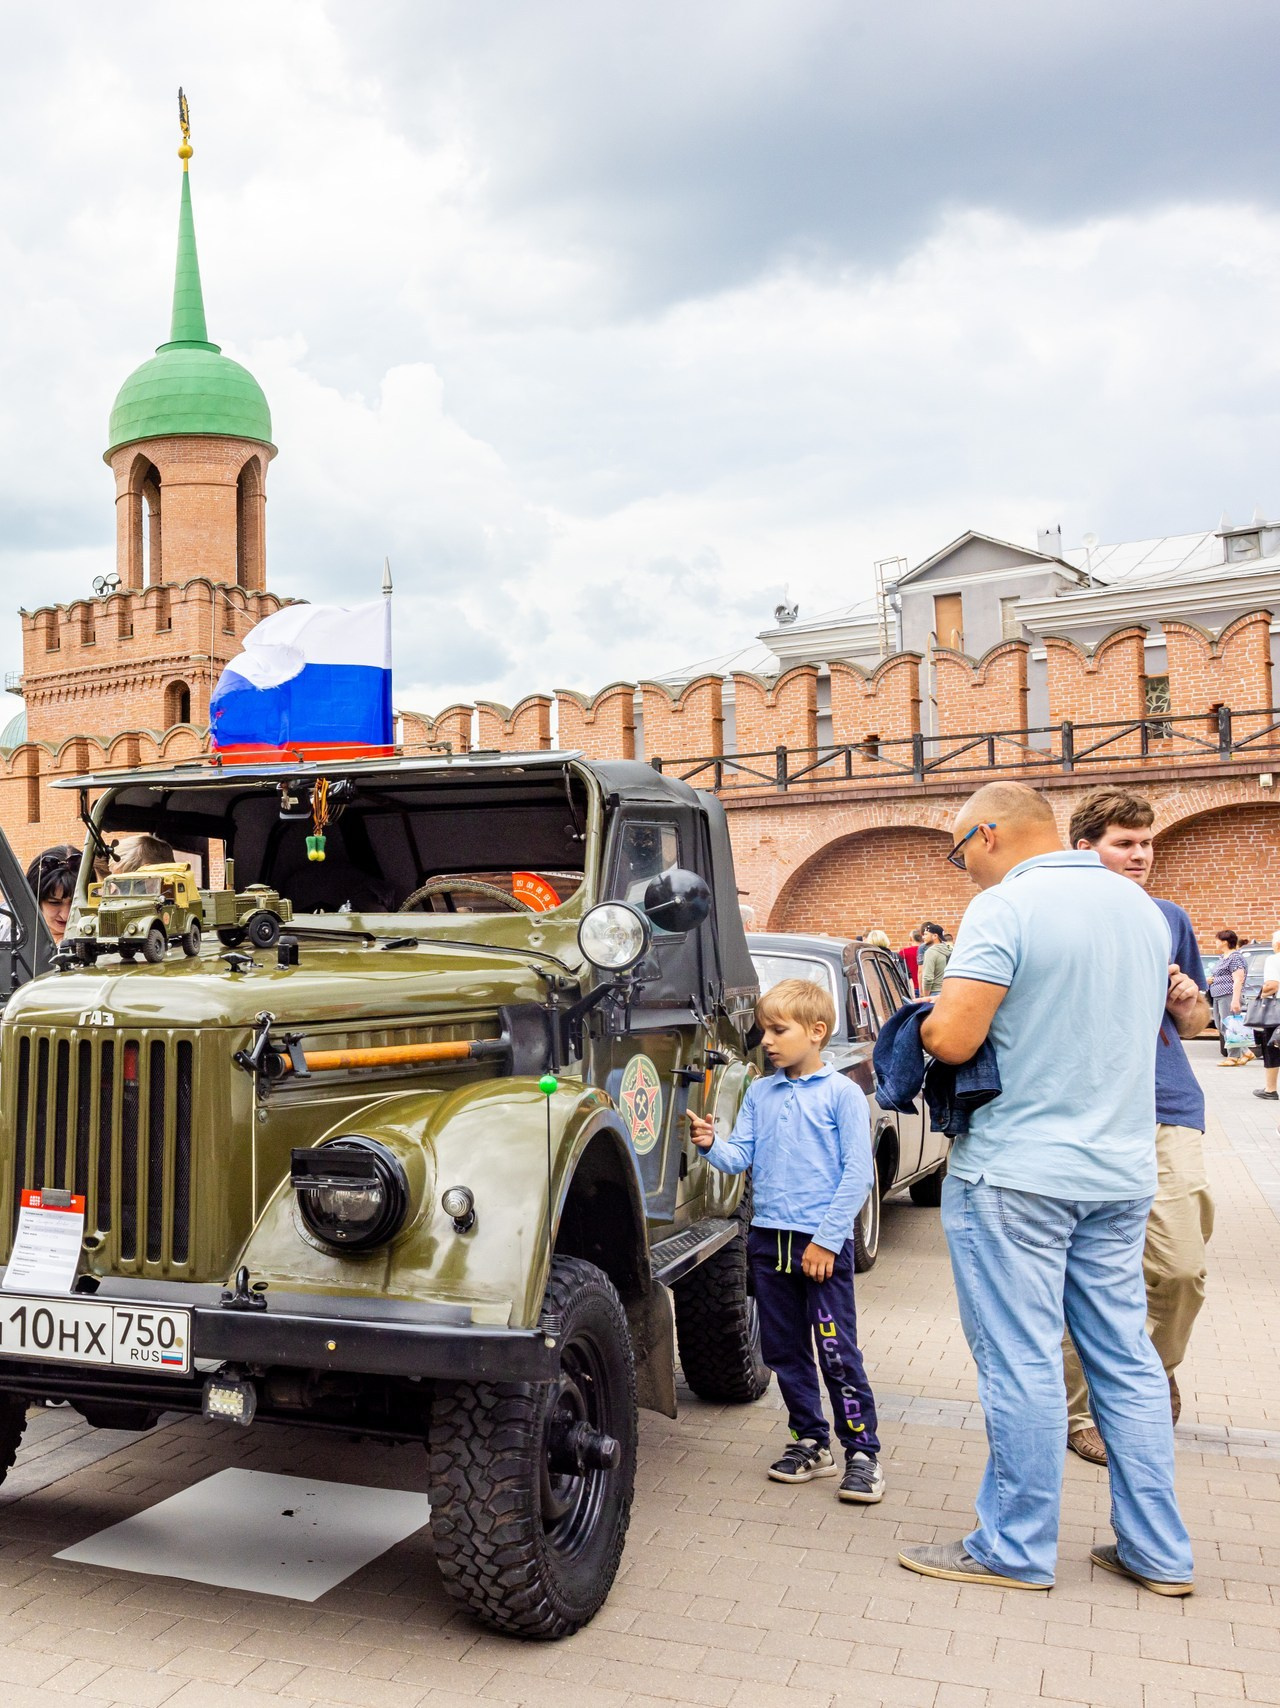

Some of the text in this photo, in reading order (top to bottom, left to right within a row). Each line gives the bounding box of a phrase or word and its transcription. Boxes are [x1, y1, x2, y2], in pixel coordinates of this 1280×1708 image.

[79, 1010, 115, 1026] ГАЗ
[116, 1312, 176, 1349] 750
[130, 1348, 160, 1363] RUS
